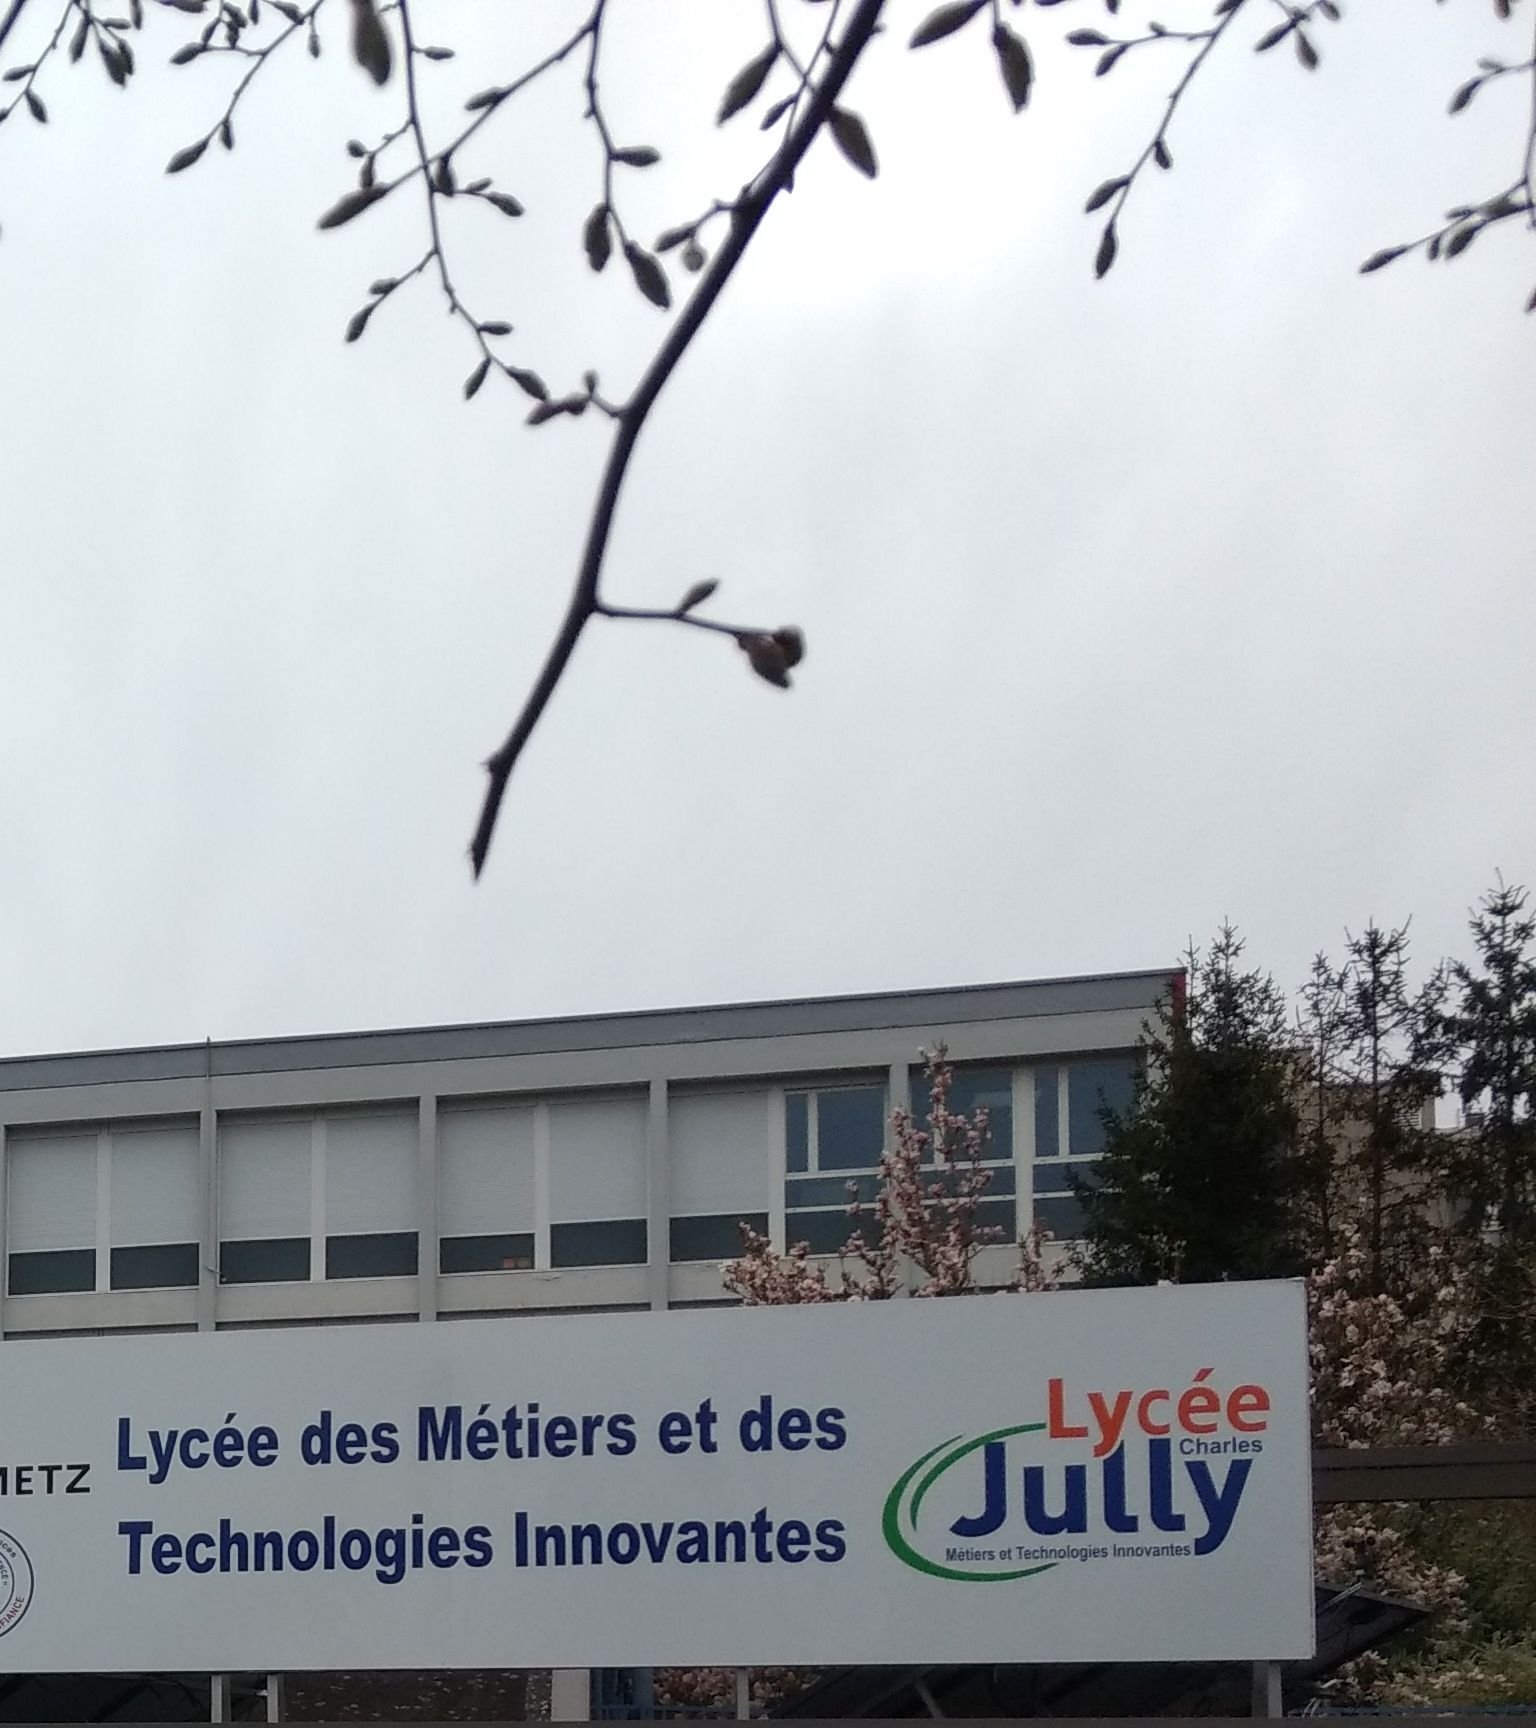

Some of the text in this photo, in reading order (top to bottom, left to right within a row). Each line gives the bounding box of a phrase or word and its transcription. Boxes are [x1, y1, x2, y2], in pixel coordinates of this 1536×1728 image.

[117, 1394, 847, 1485] Lycée des Métiers et des
[1048, 1367, 1271, 1458] Lycée
[1178, 1436, 1264, 1456] Charles
[948, 1437, 1254, 1556] Jully
[117, 1506, 847, 1585] Technologies Innovantes
[945, 1543, 1192, 1564] Métiers et Technologies Innovantes
